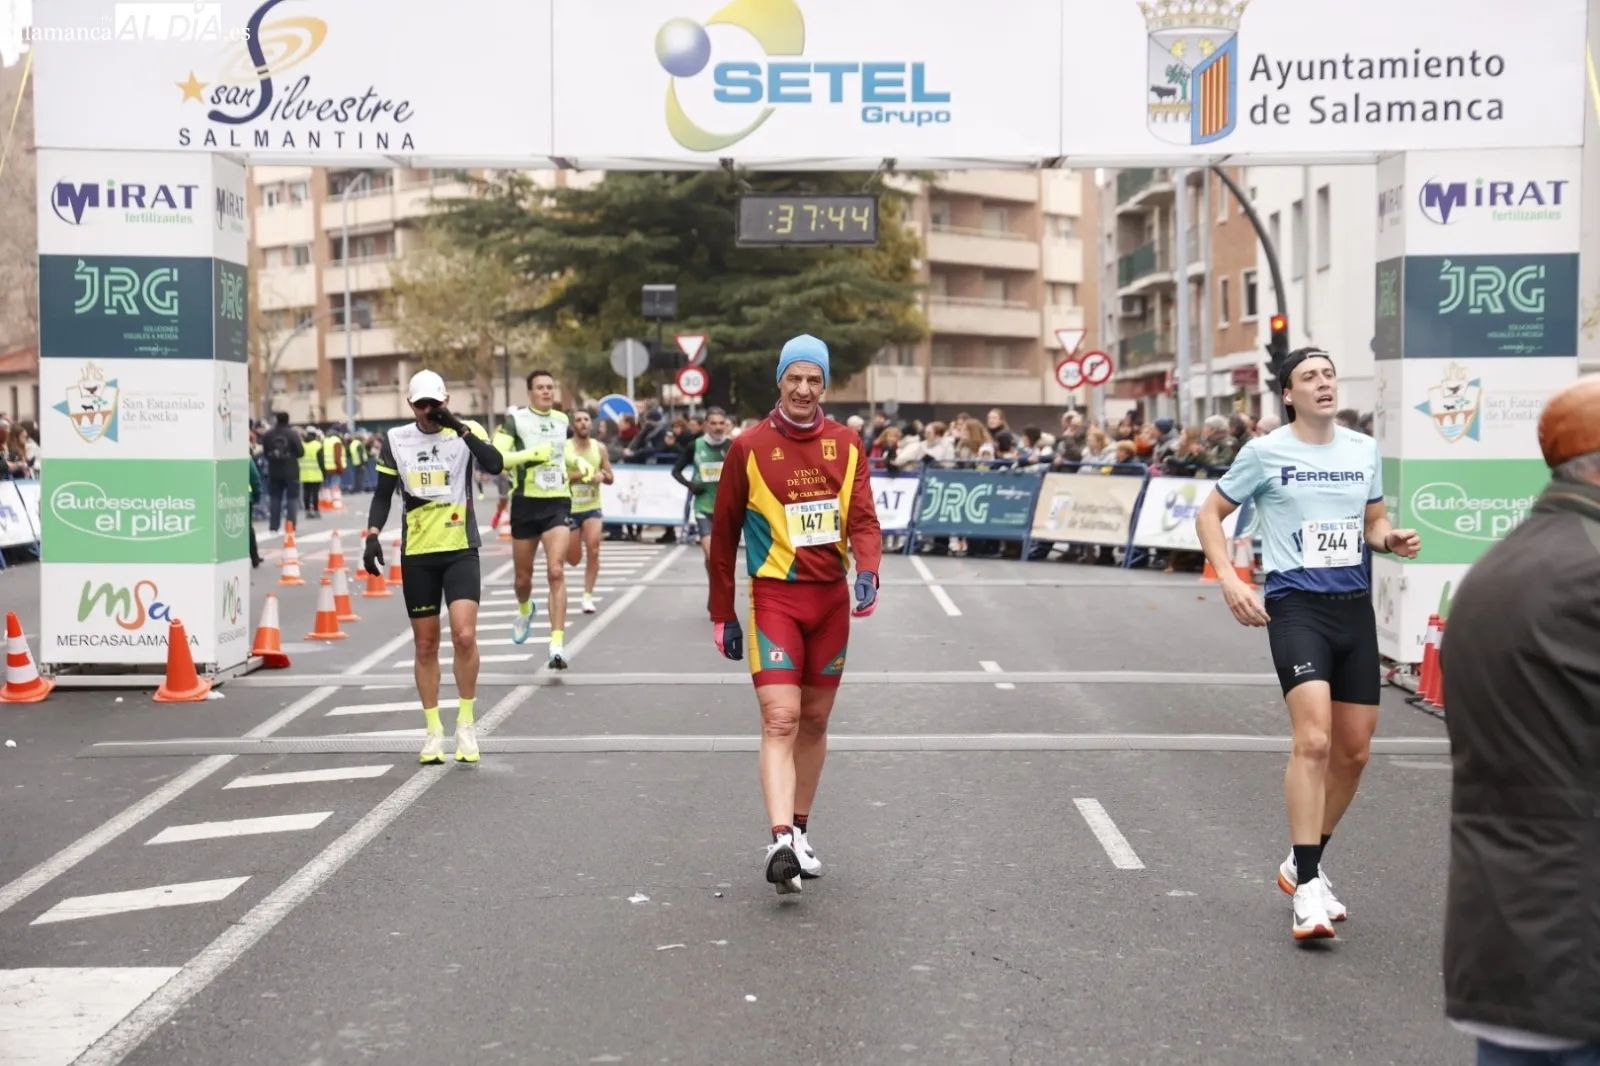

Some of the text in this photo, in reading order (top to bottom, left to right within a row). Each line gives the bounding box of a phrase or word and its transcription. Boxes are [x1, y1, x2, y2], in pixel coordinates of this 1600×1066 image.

[1249, 48, 1505, 90] Ayuntamiento
[713, 62, 951, 103] SETEL
[861, 106, 951, 127] Grupo
[1249, 93, 1505, 125] de Salamanca
[179, 128, 414, 151] SALMANTINA
[125, 211, 193, 224] fertilizantes
[1492, 210, 1561, 222] fertilizantes
[75, 259, 179, 315] JRG
[1439, 259, 1545, 314] JRG
[683, 377, 700, 387] 30
[122, 397, 205, 410] San Estanislao
[122, 410, 179, 422] de Kostka
[421, 472, 432, 485] 61
[786, 475, 827, 487] DE TORO
[794, 467, 819, 478] VINO
[1281, 465, 1364, 486] FERREIRA
[56, 492, 196, 510] autoescuelas
[800, 502, 834, 512] SETEL
[95, 511, 196, 537] el pilar
[801, 513, 823, 531] 147
[1320, 521, 1360, 531] SETEL
[1455, 510, 1525, 538] el pil
[1317, 532, 1348, 552] 244
[56, 634, 200, 647] MERCASALAMAA
